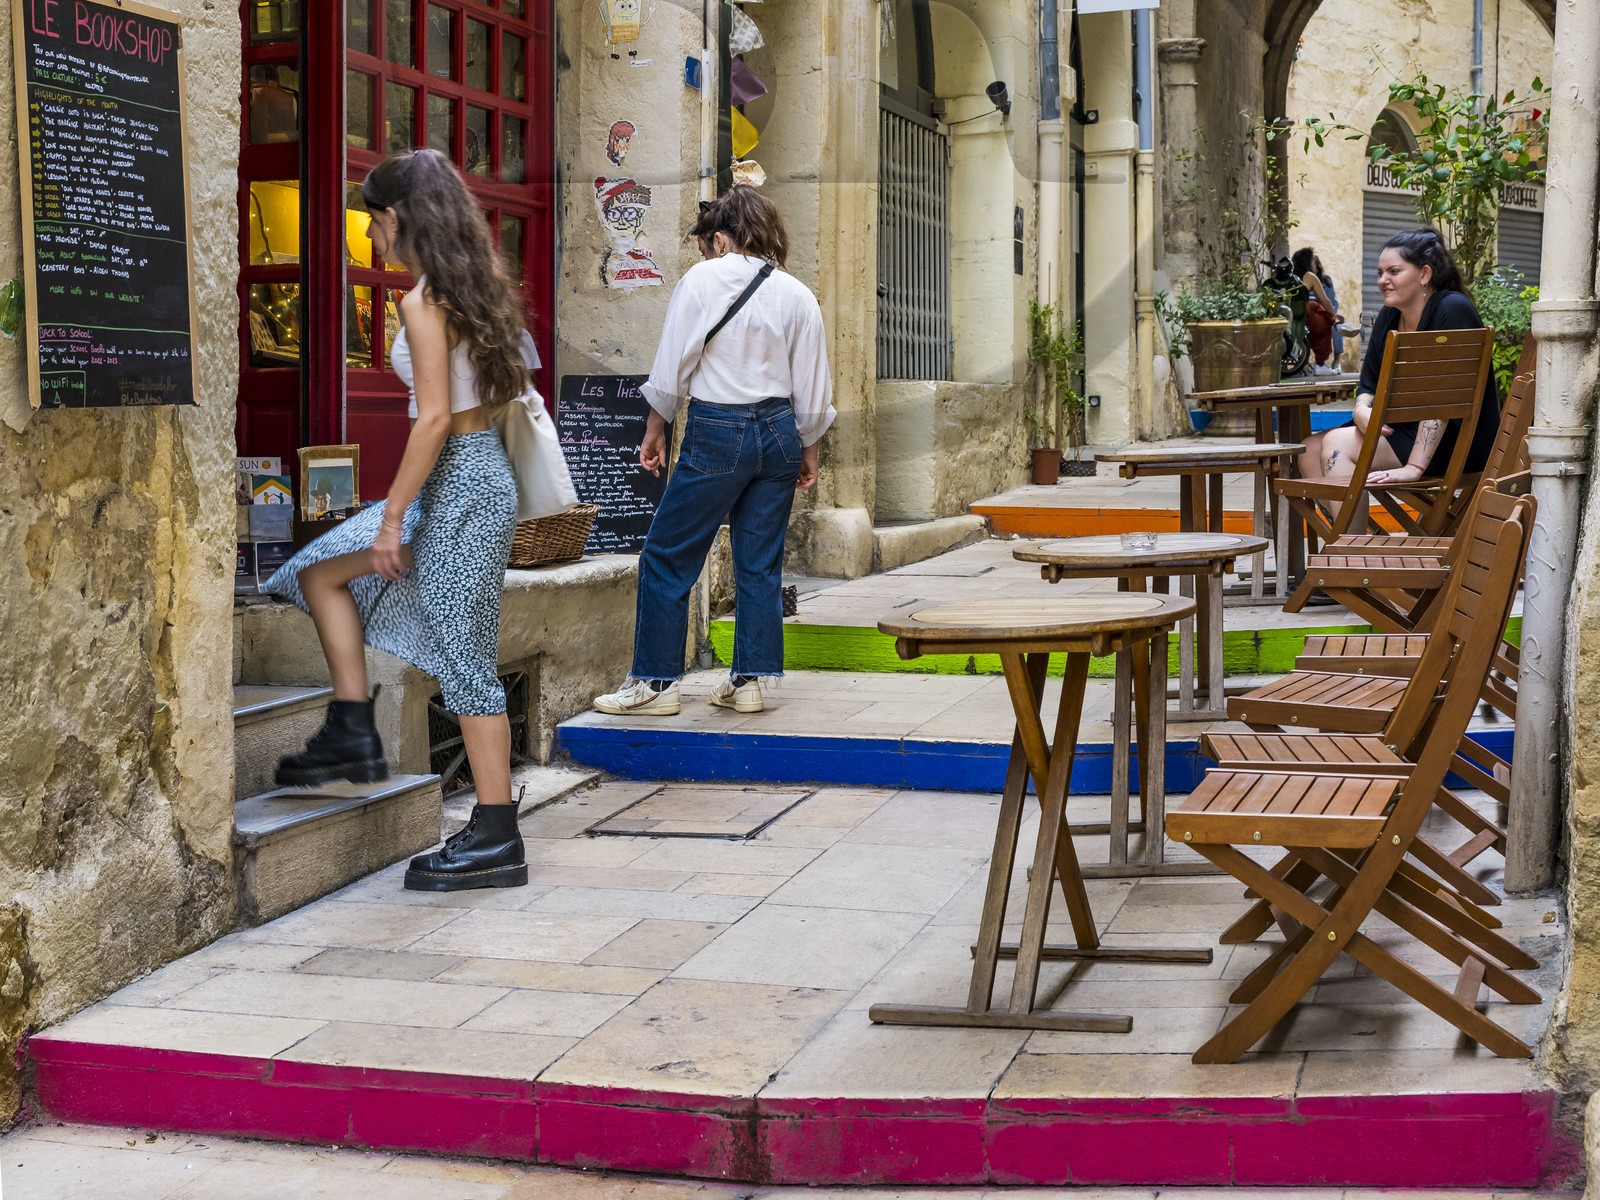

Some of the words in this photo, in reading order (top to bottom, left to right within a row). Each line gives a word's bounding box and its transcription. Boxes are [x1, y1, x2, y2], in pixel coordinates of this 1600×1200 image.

[75, 1, 171, 66] BOOKSHOP
[49, 285, 64, 294] MORE
[39, 326, 56, 339] BACK
[57, 328, 66, 337] TO
[70, 344, 88, 353] SCHOOL
[40, 379, 49, 390] No
[581, 377, 604, 397] LES
[239, 459, 259, 470] SUN
